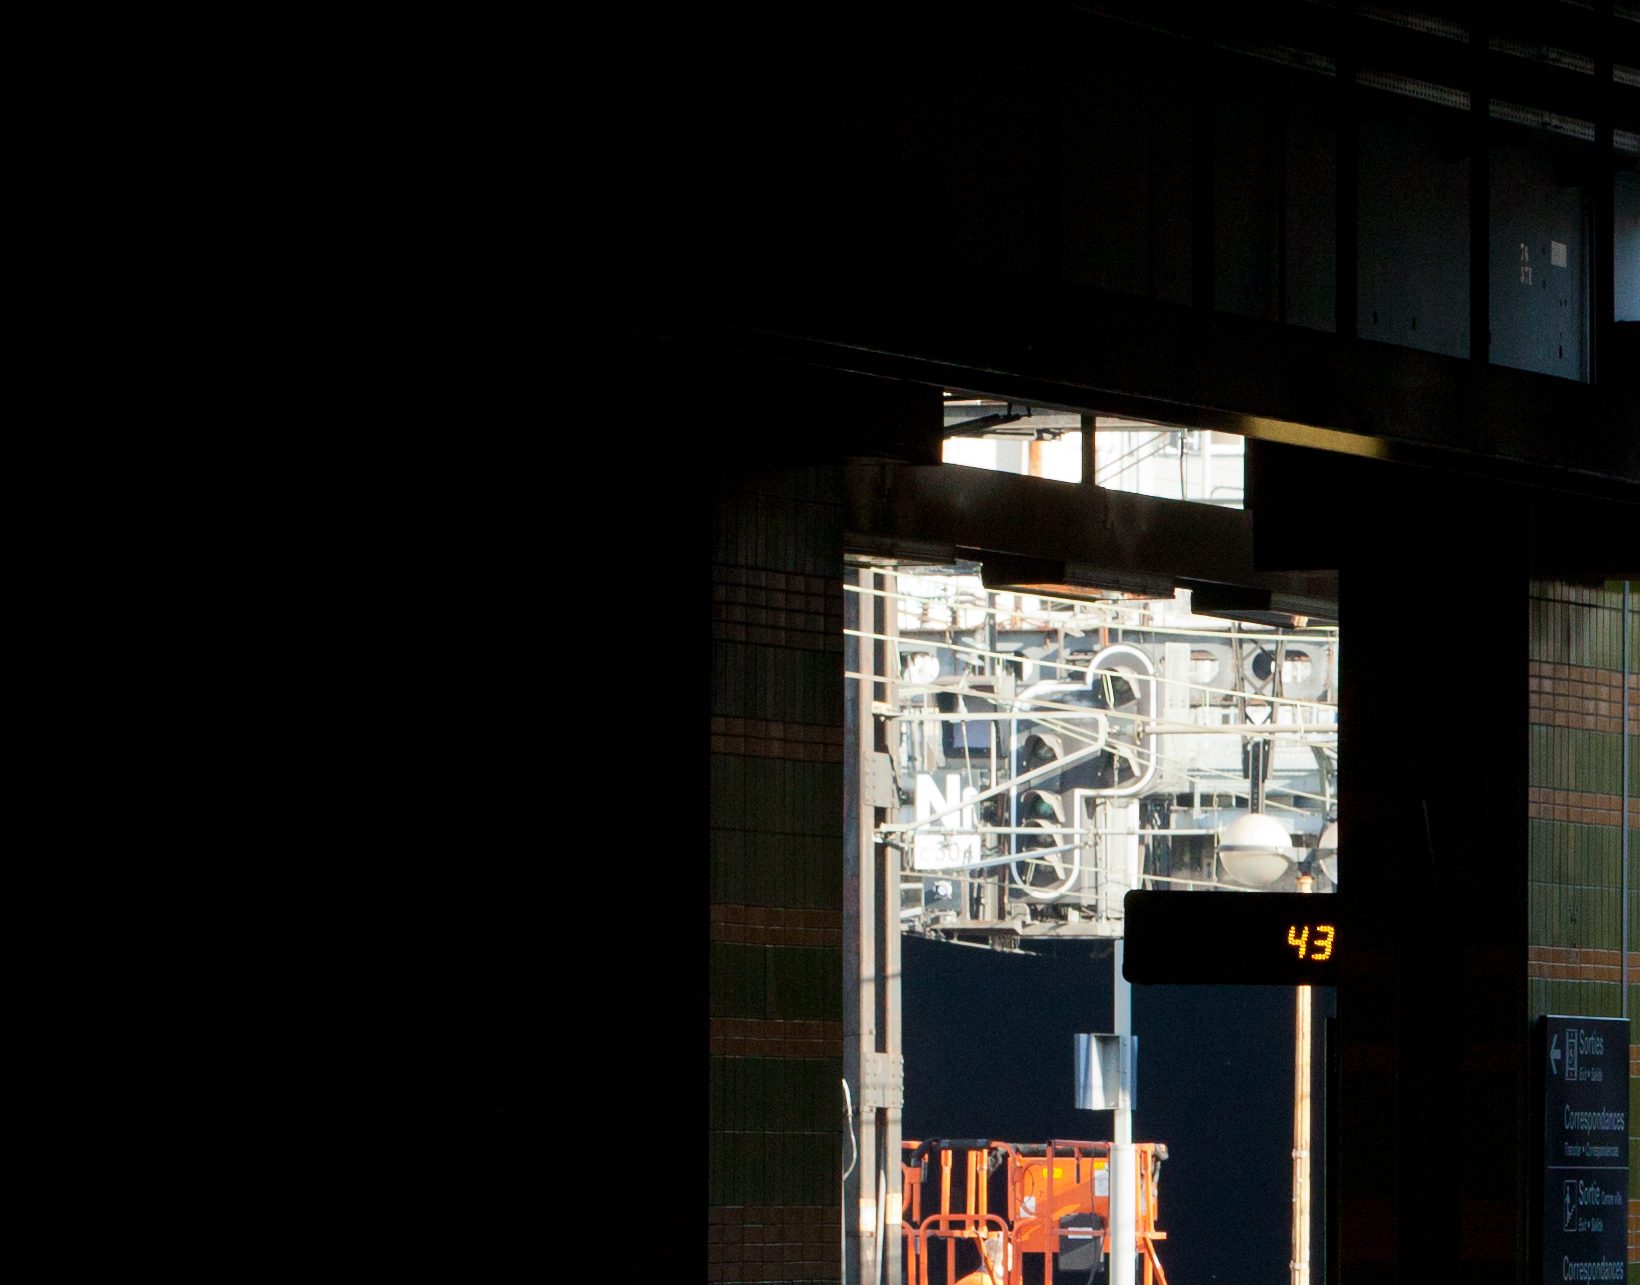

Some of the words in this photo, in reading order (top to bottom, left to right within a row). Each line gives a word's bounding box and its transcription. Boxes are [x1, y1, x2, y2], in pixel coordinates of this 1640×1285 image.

[1288, 926, 1334, 960] 43
[1579, 1029, 1604, 1055] Sorties
[1564, 1104, 1624, 1136] Correspondances
[1579, 1180, 1600, 1206] Sortie
